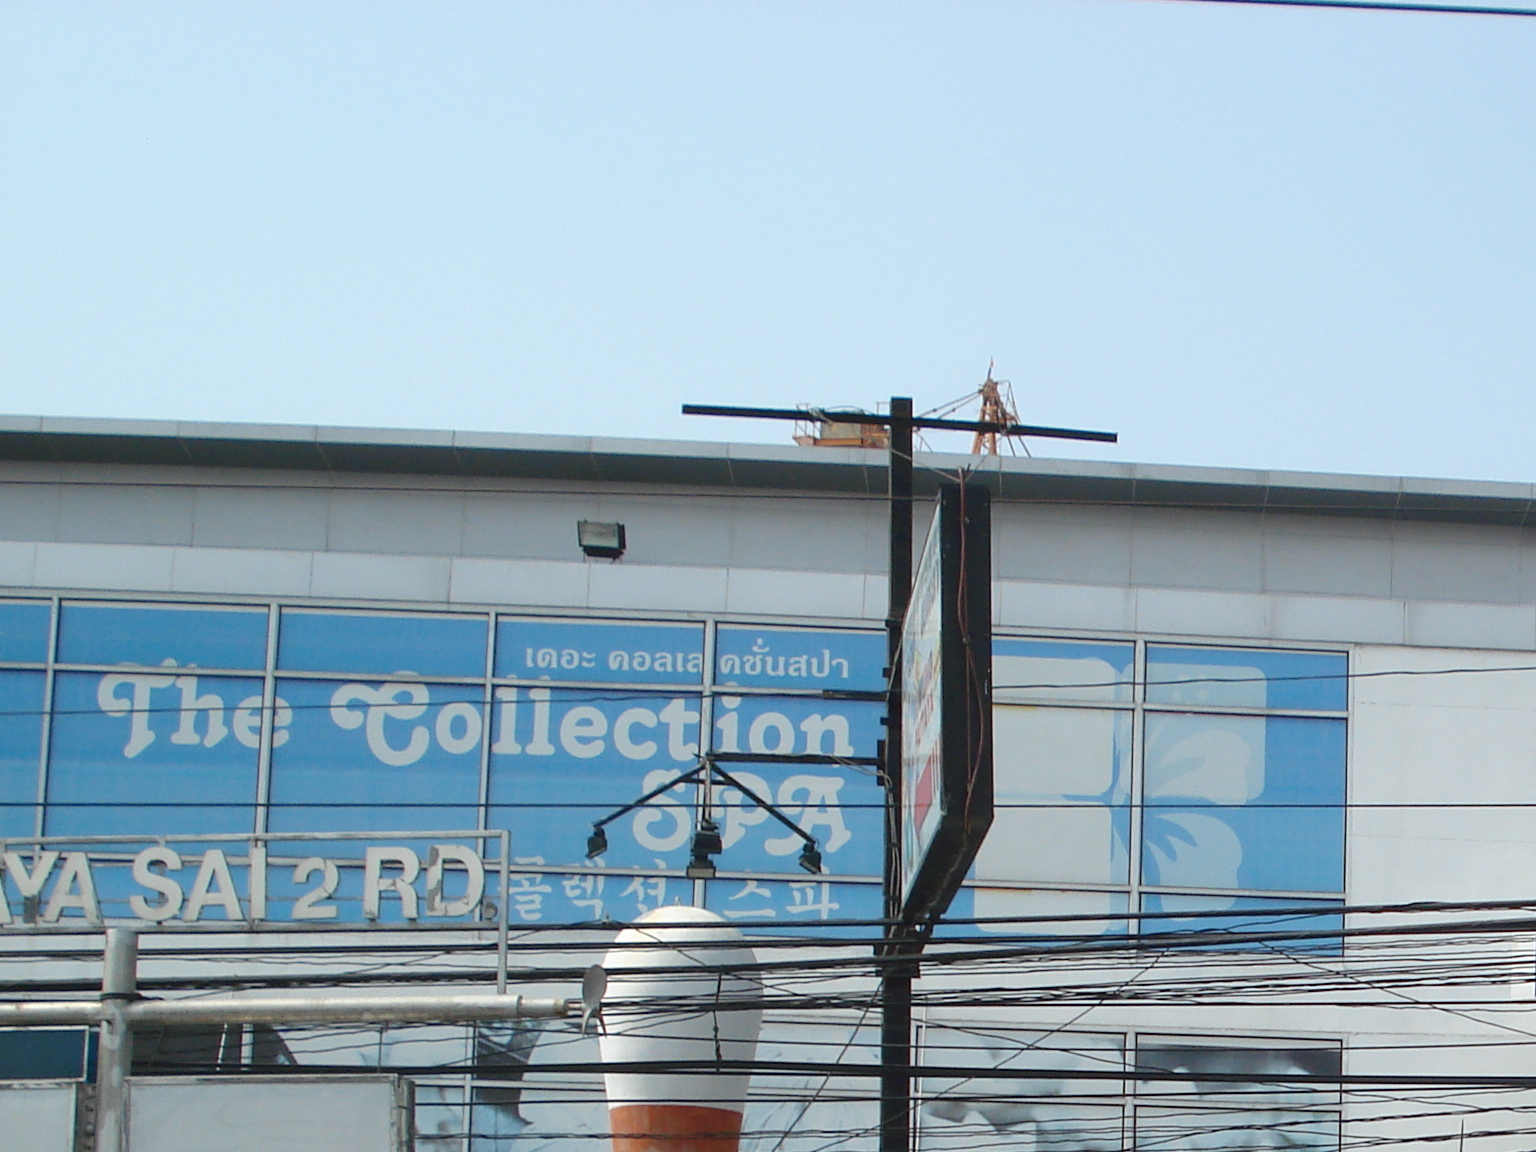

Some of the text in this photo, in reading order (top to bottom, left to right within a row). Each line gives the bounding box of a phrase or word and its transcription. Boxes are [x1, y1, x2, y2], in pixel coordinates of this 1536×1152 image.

[525, 647, 596, 669] เดอะ
[98, 658, 855, 767] The Collection
[633, 768, 851, 856] SPA
[0, 850, 102, 925] YA
[130, 846, 267, 922] SAI
[292, 857, 340, 920] 2
